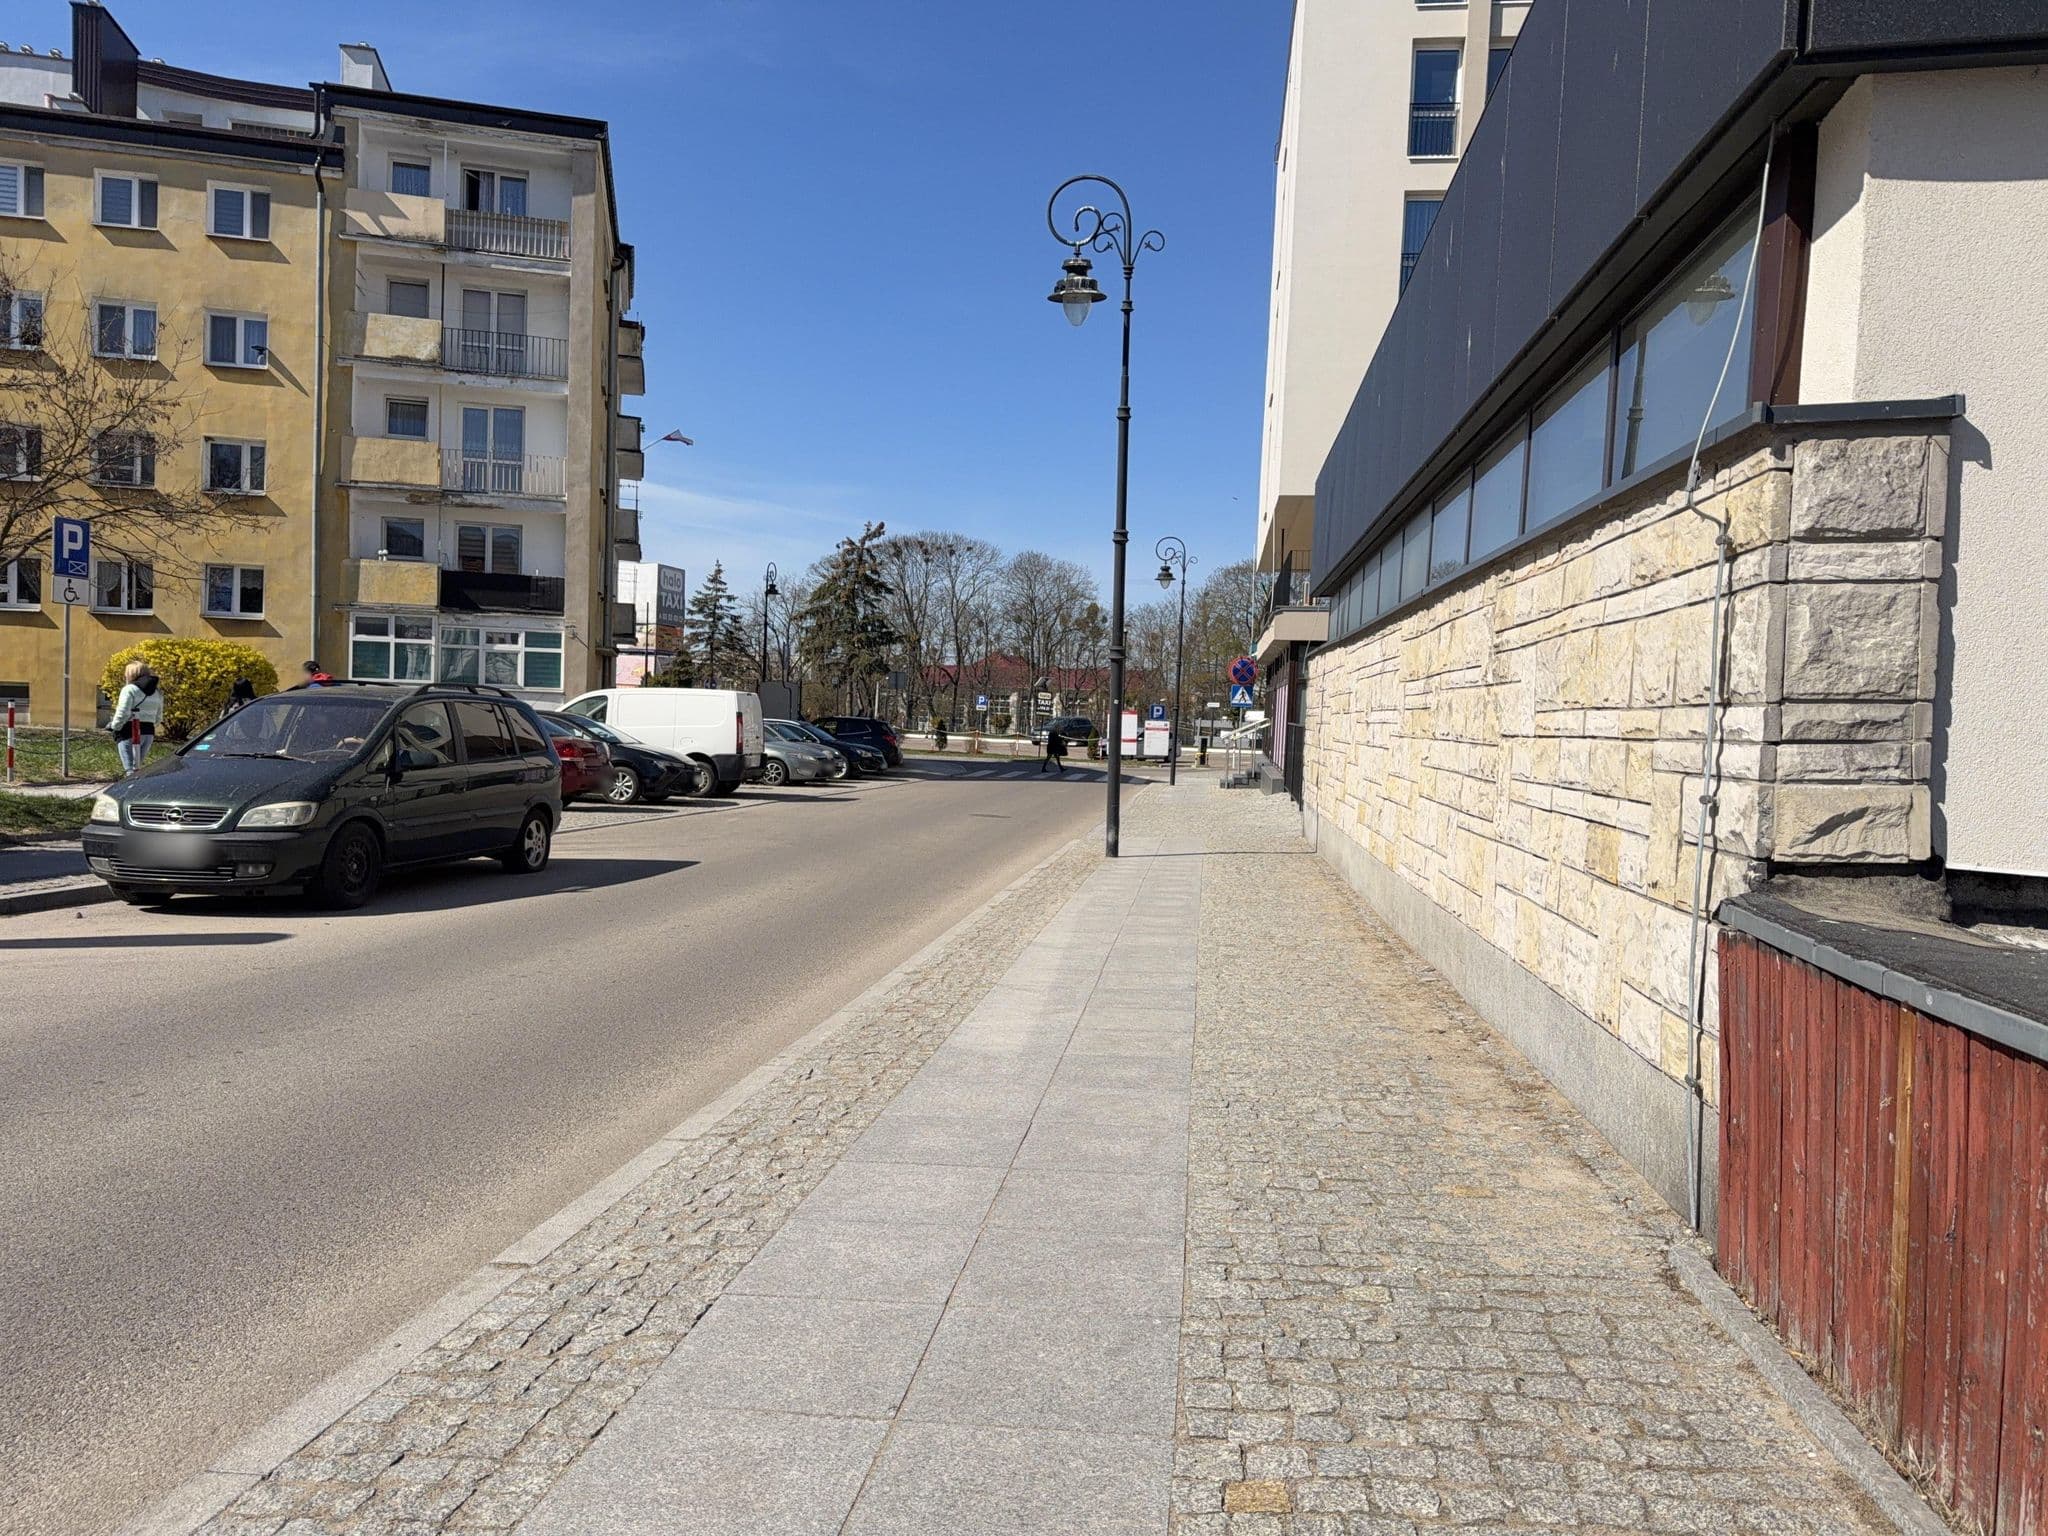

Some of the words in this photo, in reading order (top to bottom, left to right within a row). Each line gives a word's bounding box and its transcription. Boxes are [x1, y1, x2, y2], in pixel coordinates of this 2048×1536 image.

[63, 523, 83, 559] P
[663, 570, 682, 589] halo
[661, 591, 683, 610] TAXI
[978, 695, 985, 705] P
[1153, 706, 1163, 718] P
